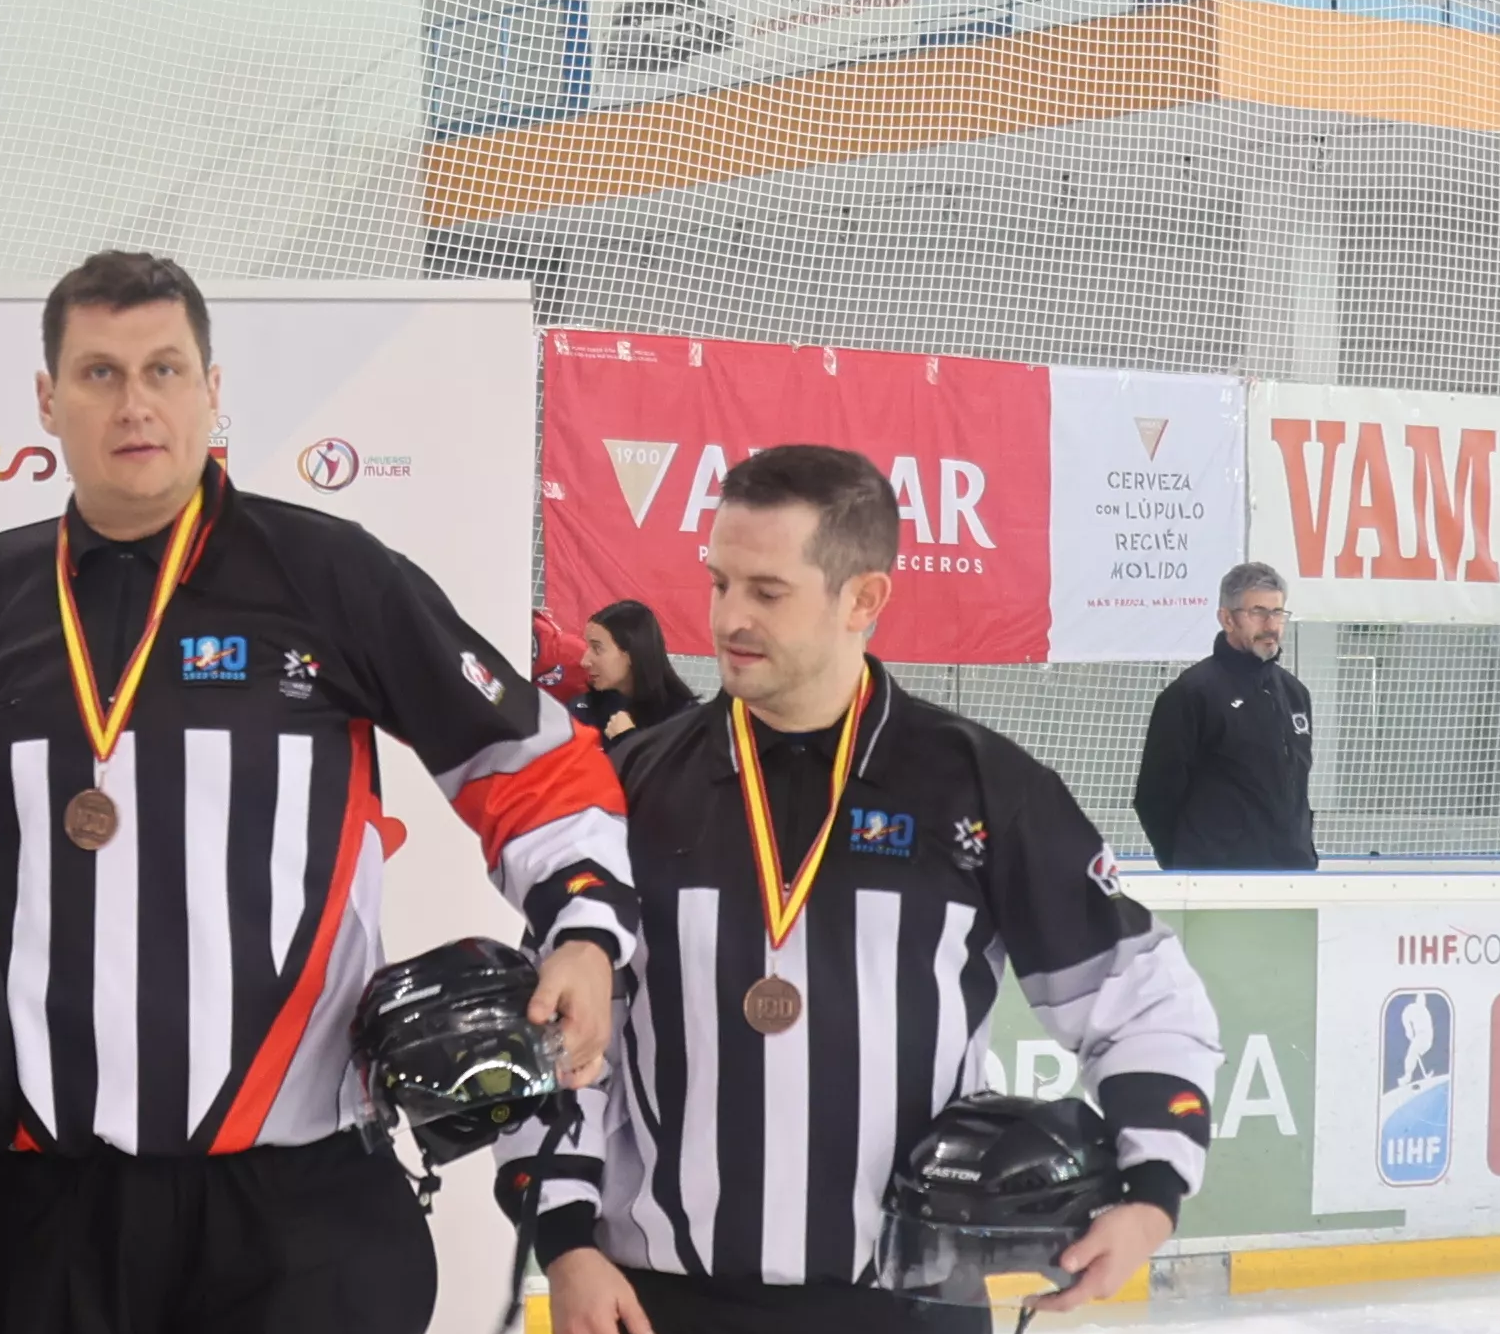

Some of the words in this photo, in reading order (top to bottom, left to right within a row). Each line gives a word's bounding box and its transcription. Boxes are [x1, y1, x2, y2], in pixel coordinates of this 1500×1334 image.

[615, 446, 661, 465] 1900
[363, 465, 411, 477] MUJER
[1106, 471, 1193, 491] CERVEZA
[1125, 498, 1205, 520] LÚPULO
[1115, 529, 1189, 552] RECIÉN
[1110, 561, 1189, 580] MOLIDO
[1387, 1136, 1442, 1165] IIHF
[921, 1165, 983, 1183] EASTON
